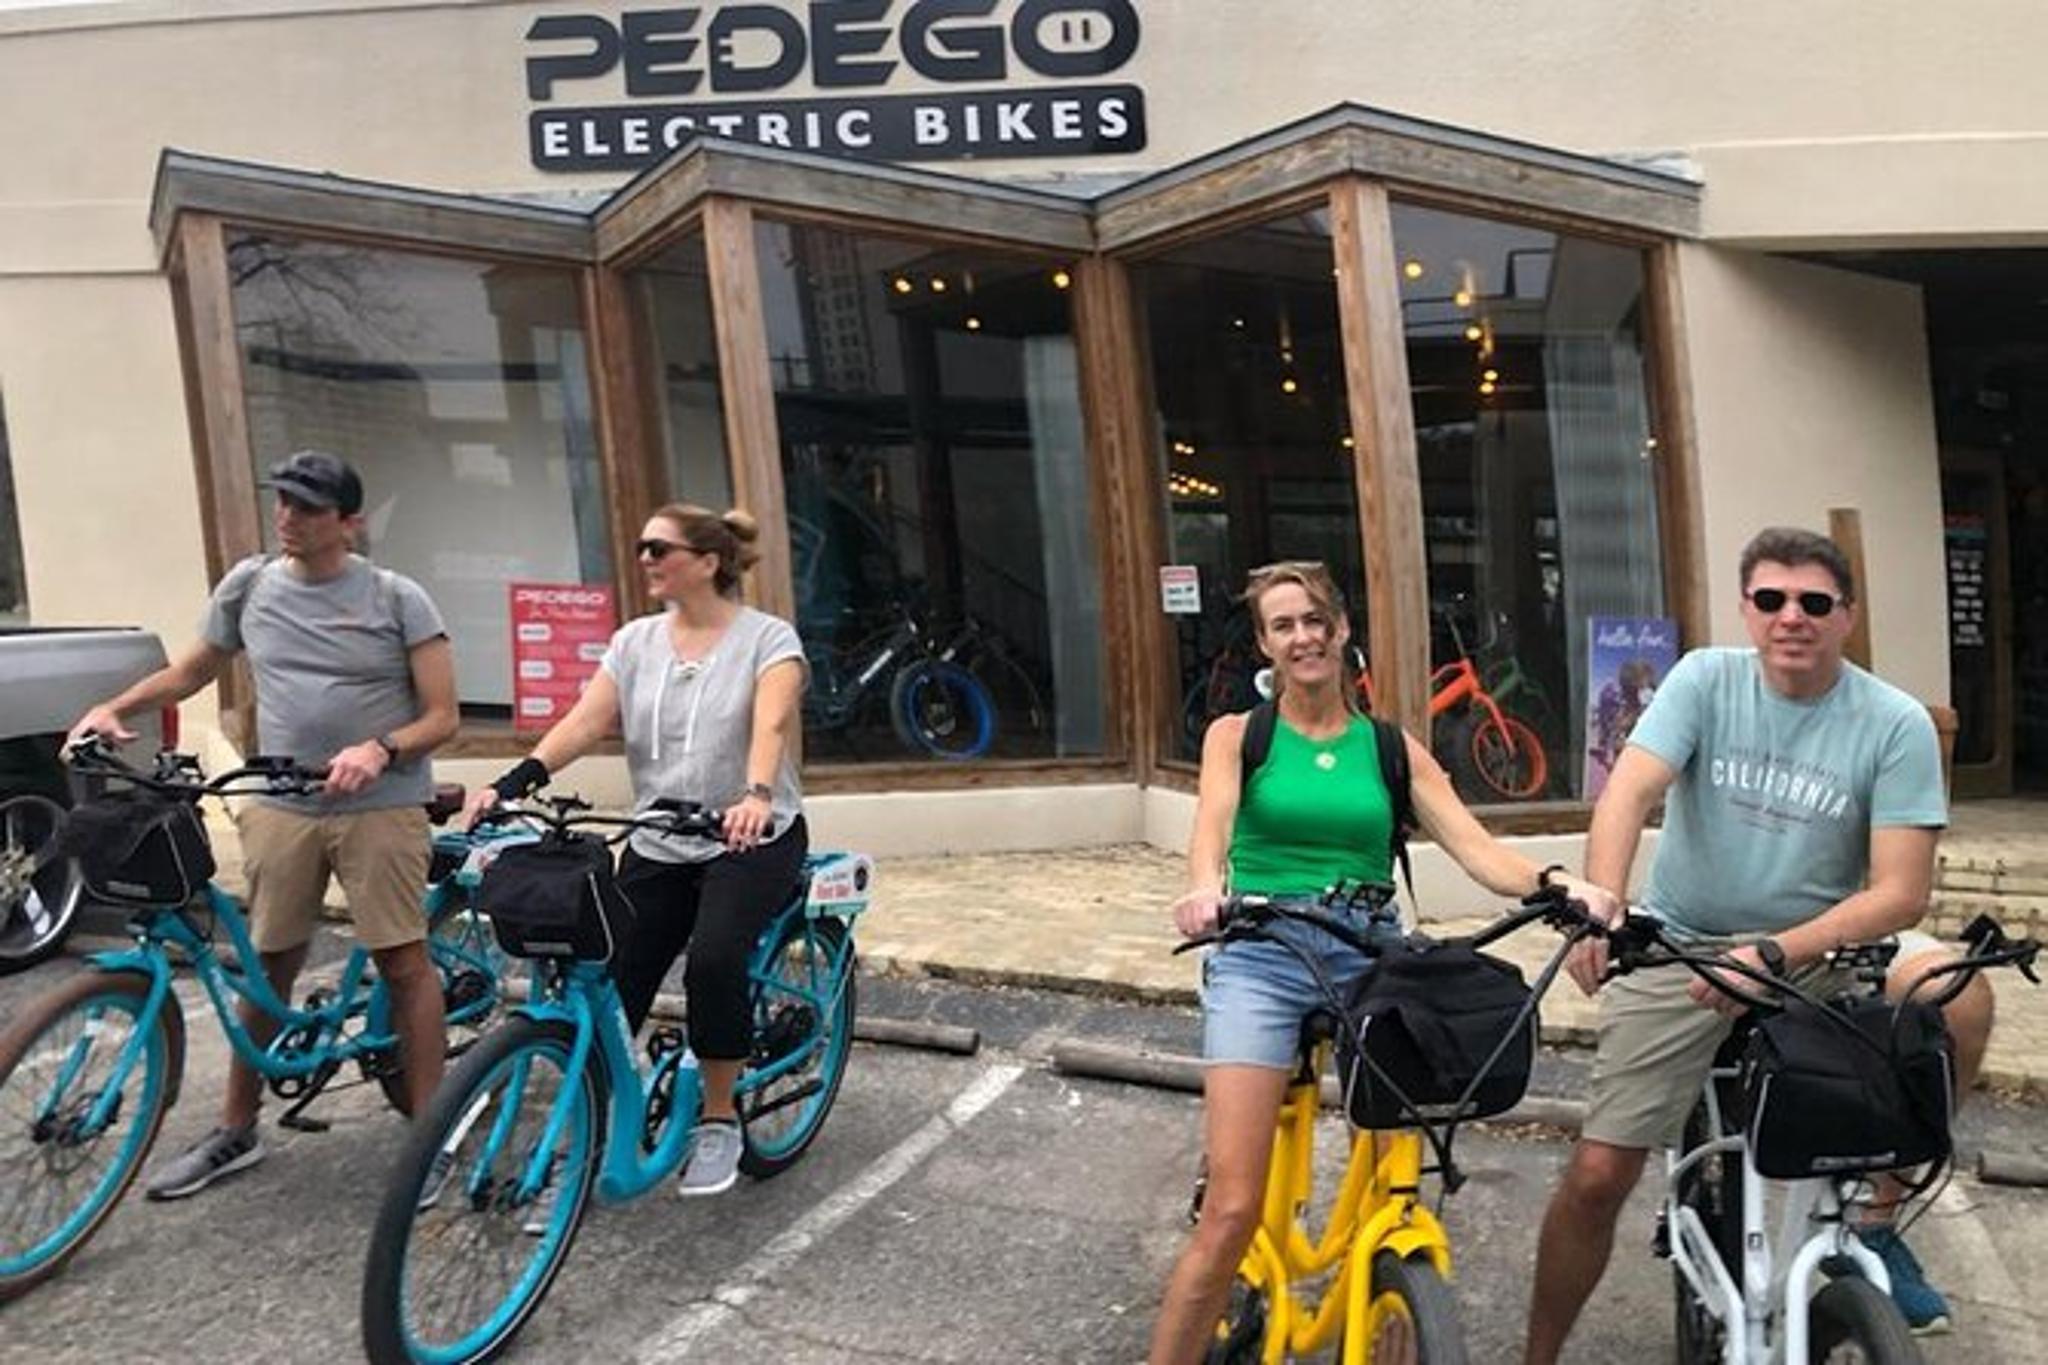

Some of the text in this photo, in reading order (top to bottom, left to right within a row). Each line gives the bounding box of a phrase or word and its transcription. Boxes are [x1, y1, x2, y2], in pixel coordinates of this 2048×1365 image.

[525, 0, 1140, 101] PEDEGO
[543, 98, 1128, 157] ELECTRIC BIKES
[1711, 758, 1848, 820] CALIFORNIA
